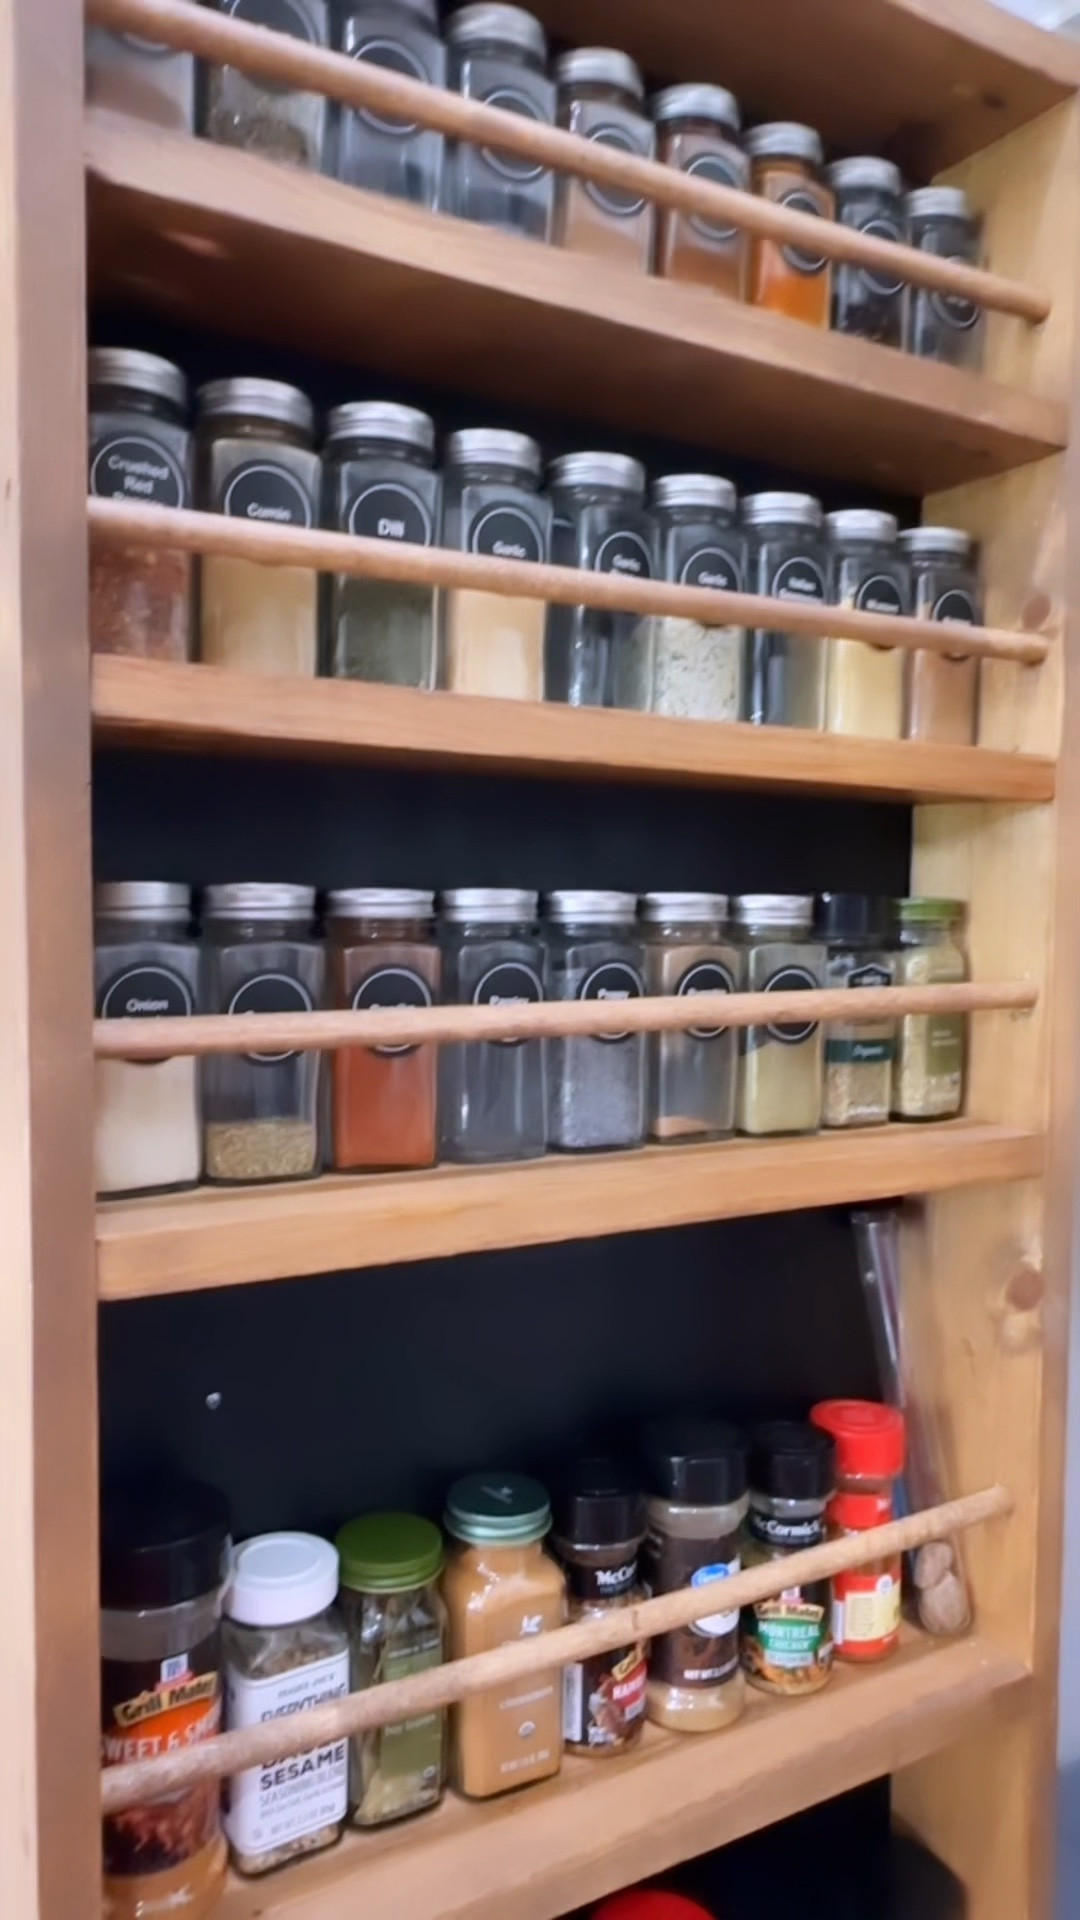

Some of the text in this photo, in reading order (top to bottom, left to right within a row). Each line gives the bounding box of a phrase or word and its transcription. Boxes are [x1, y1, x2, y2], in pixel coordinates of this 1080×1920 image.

[107, 454, 169, 480] Crushed
[123, 474, 154, 495] Red
[377, 517, 405, 538] Dill
[125, 997, 168, 1013] Onion
[261, 1744, 345, 1791] SESAME
